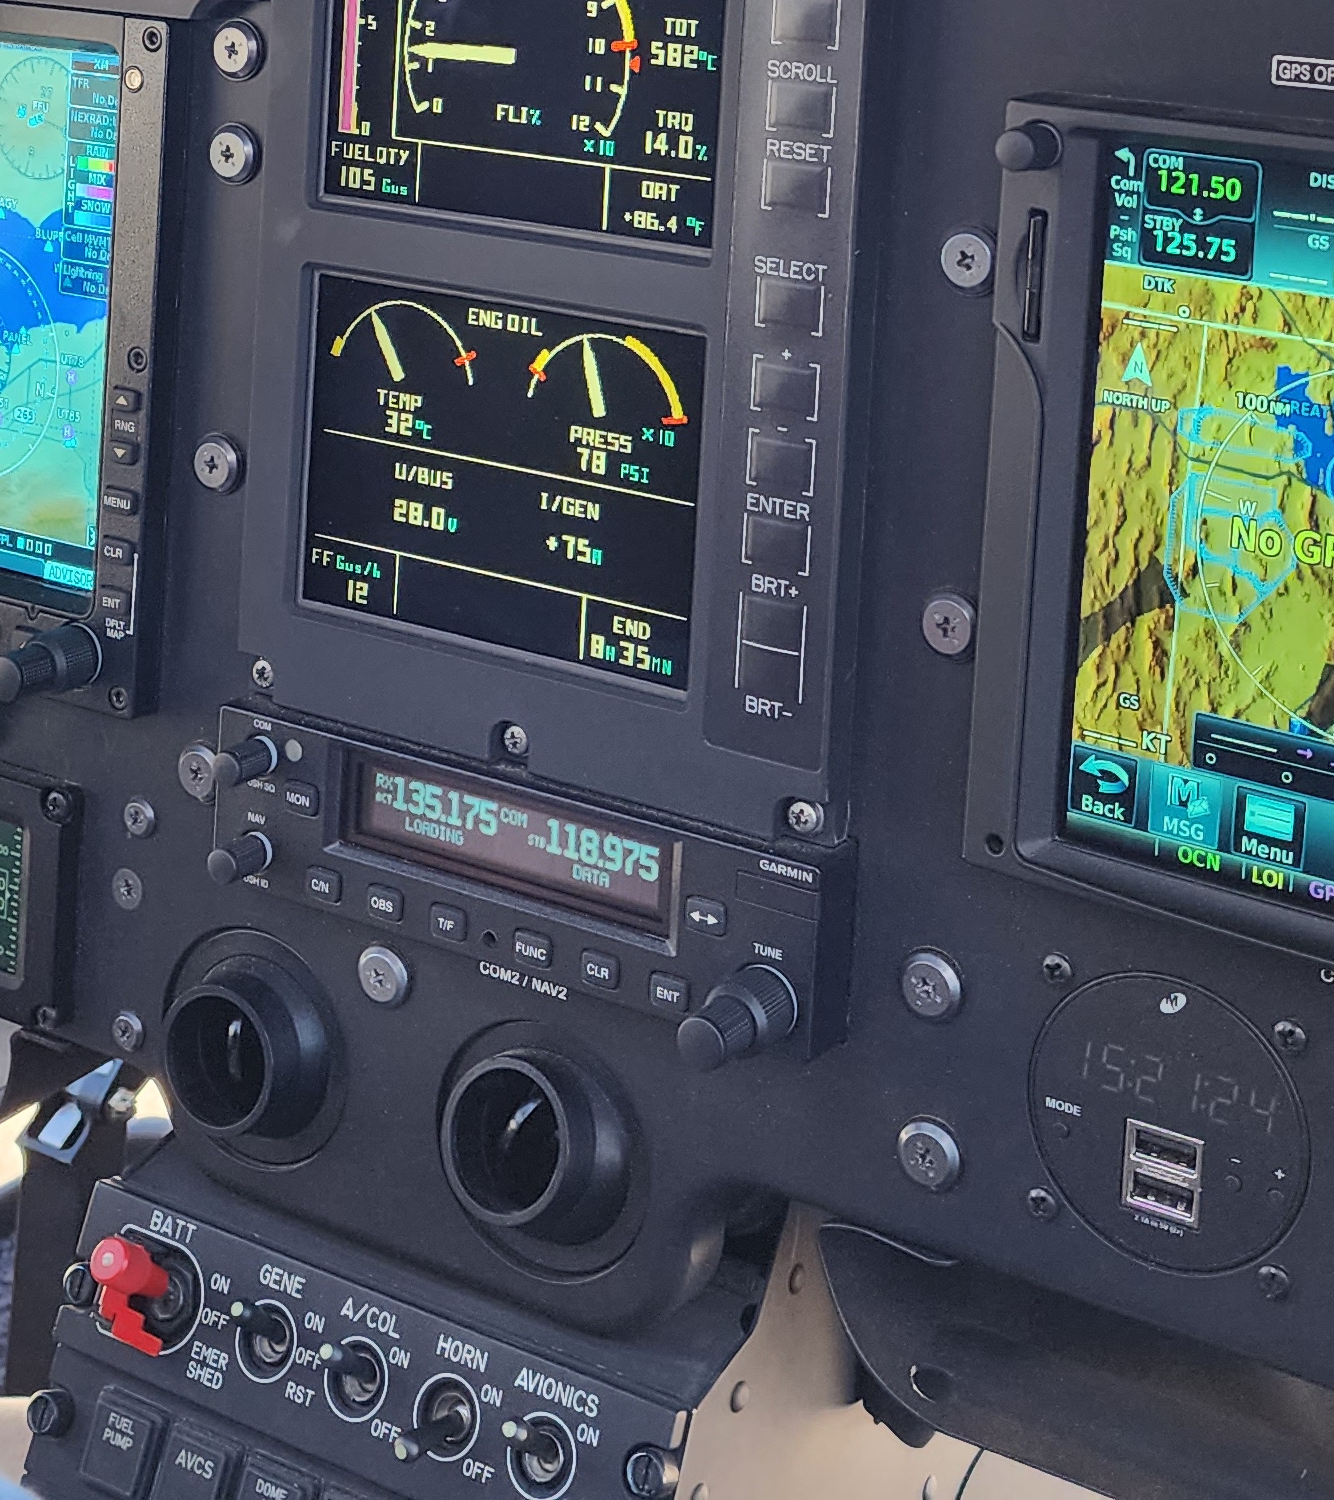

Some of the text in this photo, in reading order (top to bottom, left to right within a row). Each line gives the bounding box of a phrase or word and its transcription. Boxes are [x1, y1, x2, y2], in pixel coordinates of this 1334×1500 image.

[665, 17, 699, 37] TOT
[767, 59, 838, 84] SCROLL
[1278, 62, 1311, 81] GPS
[655, 110, 694, 132] TRQ
[766, 139, 832, 163] RESET
[1148, 153, 1184, 171] COM
[340, 165, 375, 191] 105
[1158, 169, 1243, 202] 121.50
[81, 200, 111, 214] SNOW
[1143, 214, 1183, 232] STBY
[1153, 229, 1237, 263] 125.75
[1308, 234, 1330, 252] GS
[755, 256, 827, 283] SELECT
[1143, 275, 1176, 294] DTK
[468, 307, 543, 337] ENG OIL
[377, 388, 422, 411] TEMP
[1103, 390, 1171, 412] NORTH UP
[115, 420, 135, 433] RNG
[569, 425, 633, 454] PRESS
[103, 496, 131, 509] MENU
[747, 492, 810, 521] ENTER
[1230, 516, 1282, 558] No
[104, 545, 123, 559] CLR
[751, 573, 799, 599] BRT+
[102, 597, 121, 609] ENT
[105, 617, 125, 630] DFLT
[106, 626, 125, 639] MAP
[613, 615, 651, 641] END
[1119, 693, 1141, 711] GS
[253, 719, 272, 731] COM
[287, 792, 310, 807] MON
[376, 773, 499, 836] RX 135.175
[1081, 795, 1126, 821] Back
[248, 812, 265, 825] NAV
[500, 807, 528, 828] COM
[1163, 816, 1205, 840] MSG
[405, 817, 464, 846] LOADING
[546, 818, 660, 882] 118.975
[1241, 836, 1295, 865] Menu
[572, 864, 610, 888] DATA
[759, 858, 813, 883] GARMIN
[311, 879, 329, 893] C/N
[371, 897, 393, 912] OBS
[515, 941, 547, 961] FUNC
[752, 942, 783, 960] TUNE
[479, 961, 568, 1001] COM2 NAV2
[586, 962, 609, 981] CLR
[656, 985, 680, 1004] ENT
[1045, 1096, 1082, 1117] MODE
[150, 1210, 197, 1244] BATT
[211, 1273, 230, 1294] ON
[259, 1264, 307, 1299] GENE
[201, 1307, 230, 1330] OFF
[304, 1312, 325, 1334] ON
[340, 1297, 400, 1340] A/COL
[191, 1340, 229, 1372] EMER
[389, 1346, 411, 1370] ON
[436, 1334, 489, 1373] HORN
[186, 1360, 224, 1390] SHED
[285, 1382, 315, 1407] RST
[481, 1383, 503, 1407] ON
[515, 1367, 600, 1418] AVIONICS
[107, 1412, 135, 1436] FUEL
[576, 1423, 600, 1447] ON
[102, 1427, 133, 1450] PUMP
[175, 1449, 214, 1480] AVCS
[462, 1458, 495, 1483] OFF
